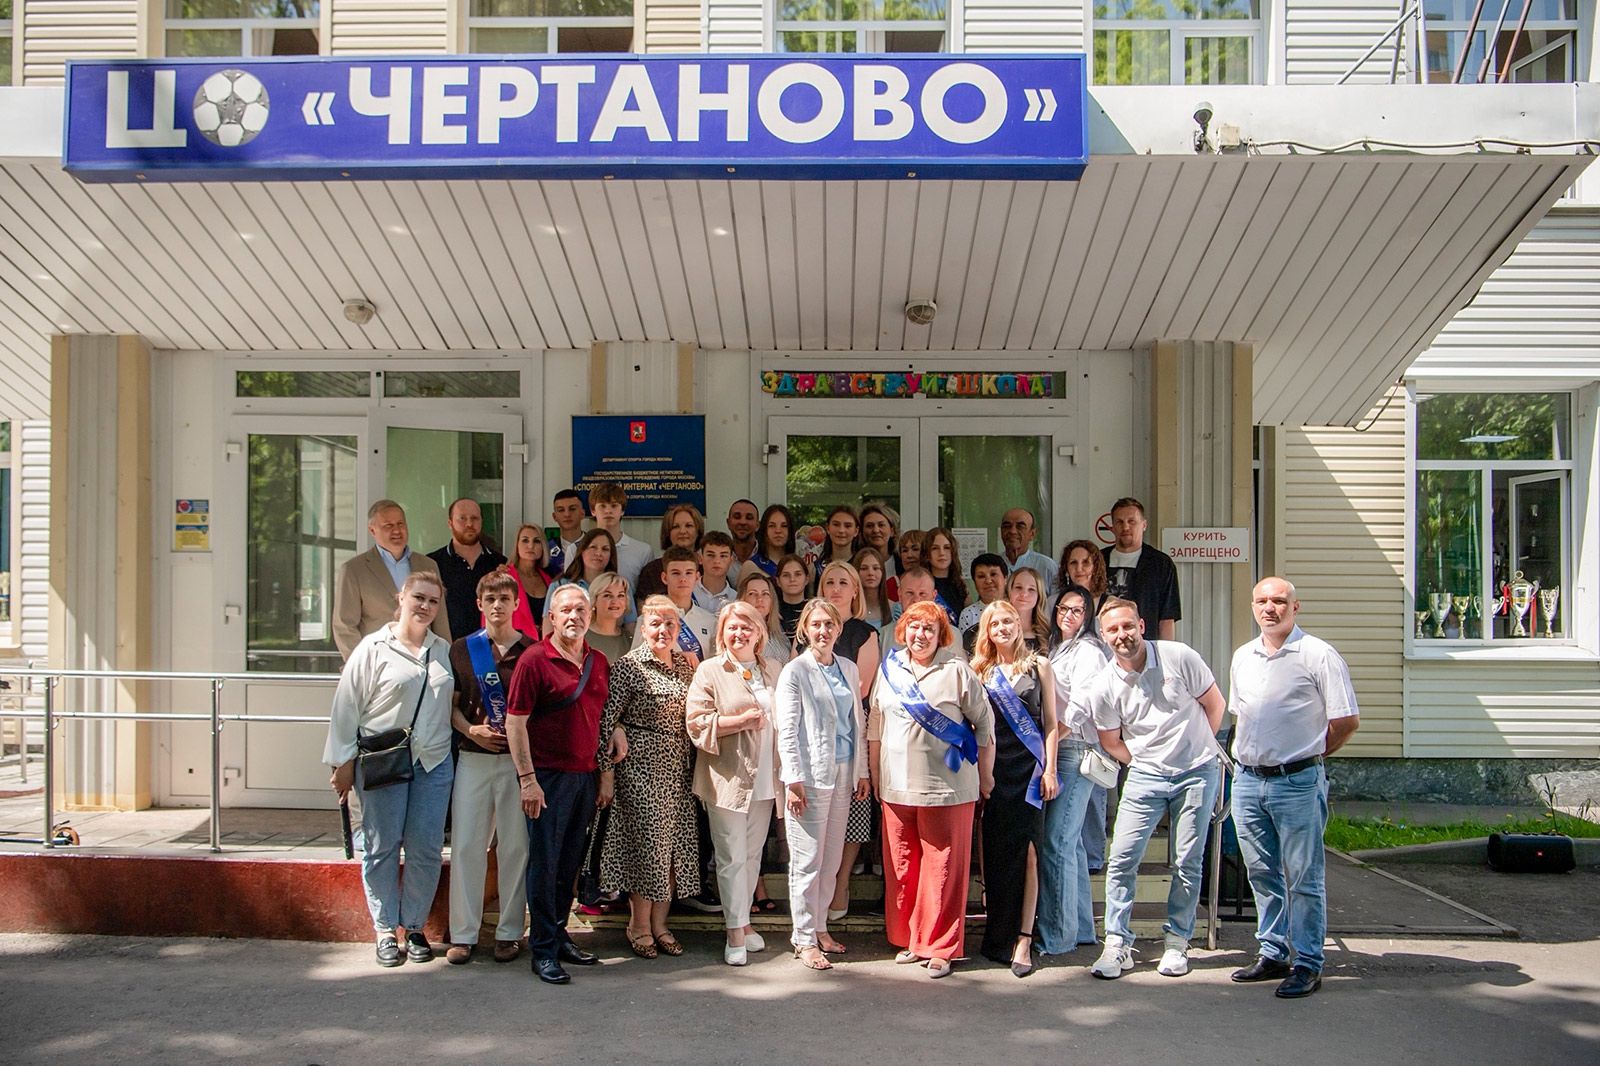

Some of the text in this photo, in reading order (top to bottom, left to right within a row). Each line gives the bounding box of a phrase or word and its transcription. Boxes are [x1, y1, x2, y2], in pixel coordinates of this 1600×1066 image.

[301, 62, 1059, 145] «ЧЕРТАНОВО»
[623, 482, 657, 491] ИНТЕРНАТ
[658, 482, 704, 490] «ЧЕРТАНОВО»
[1183, 532, 1227, 542] КУРИТЬ
[1170, 547, 1241, 560] ЗАПРЕЩЕНО
